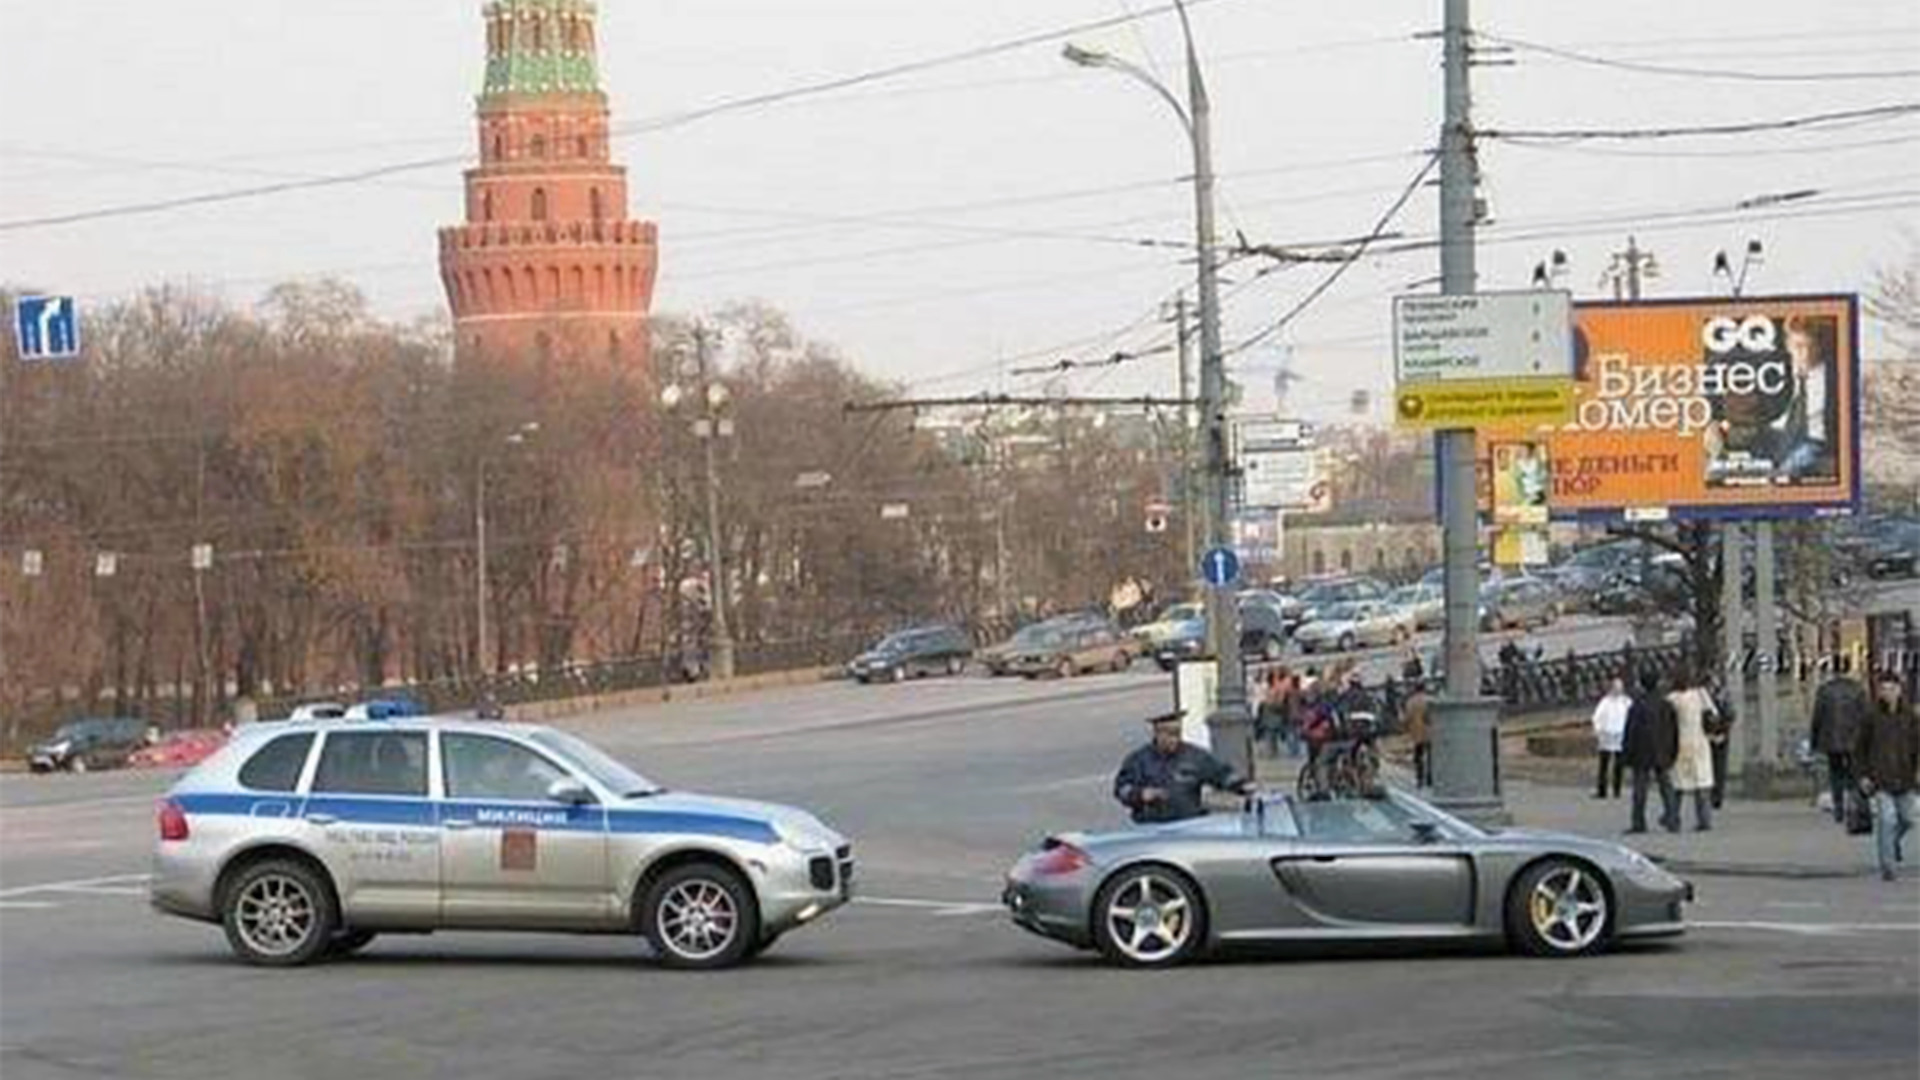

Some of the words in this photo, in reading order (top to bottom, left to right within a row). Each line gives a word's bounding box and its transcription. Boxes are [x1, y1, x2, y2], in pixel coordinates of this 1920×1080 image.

[1703, 316, 1777, 352] GQ
[1597, 352, 1786, 398] Бизнес
[476, 807, 568, 826] МИЛИЦИЯ
